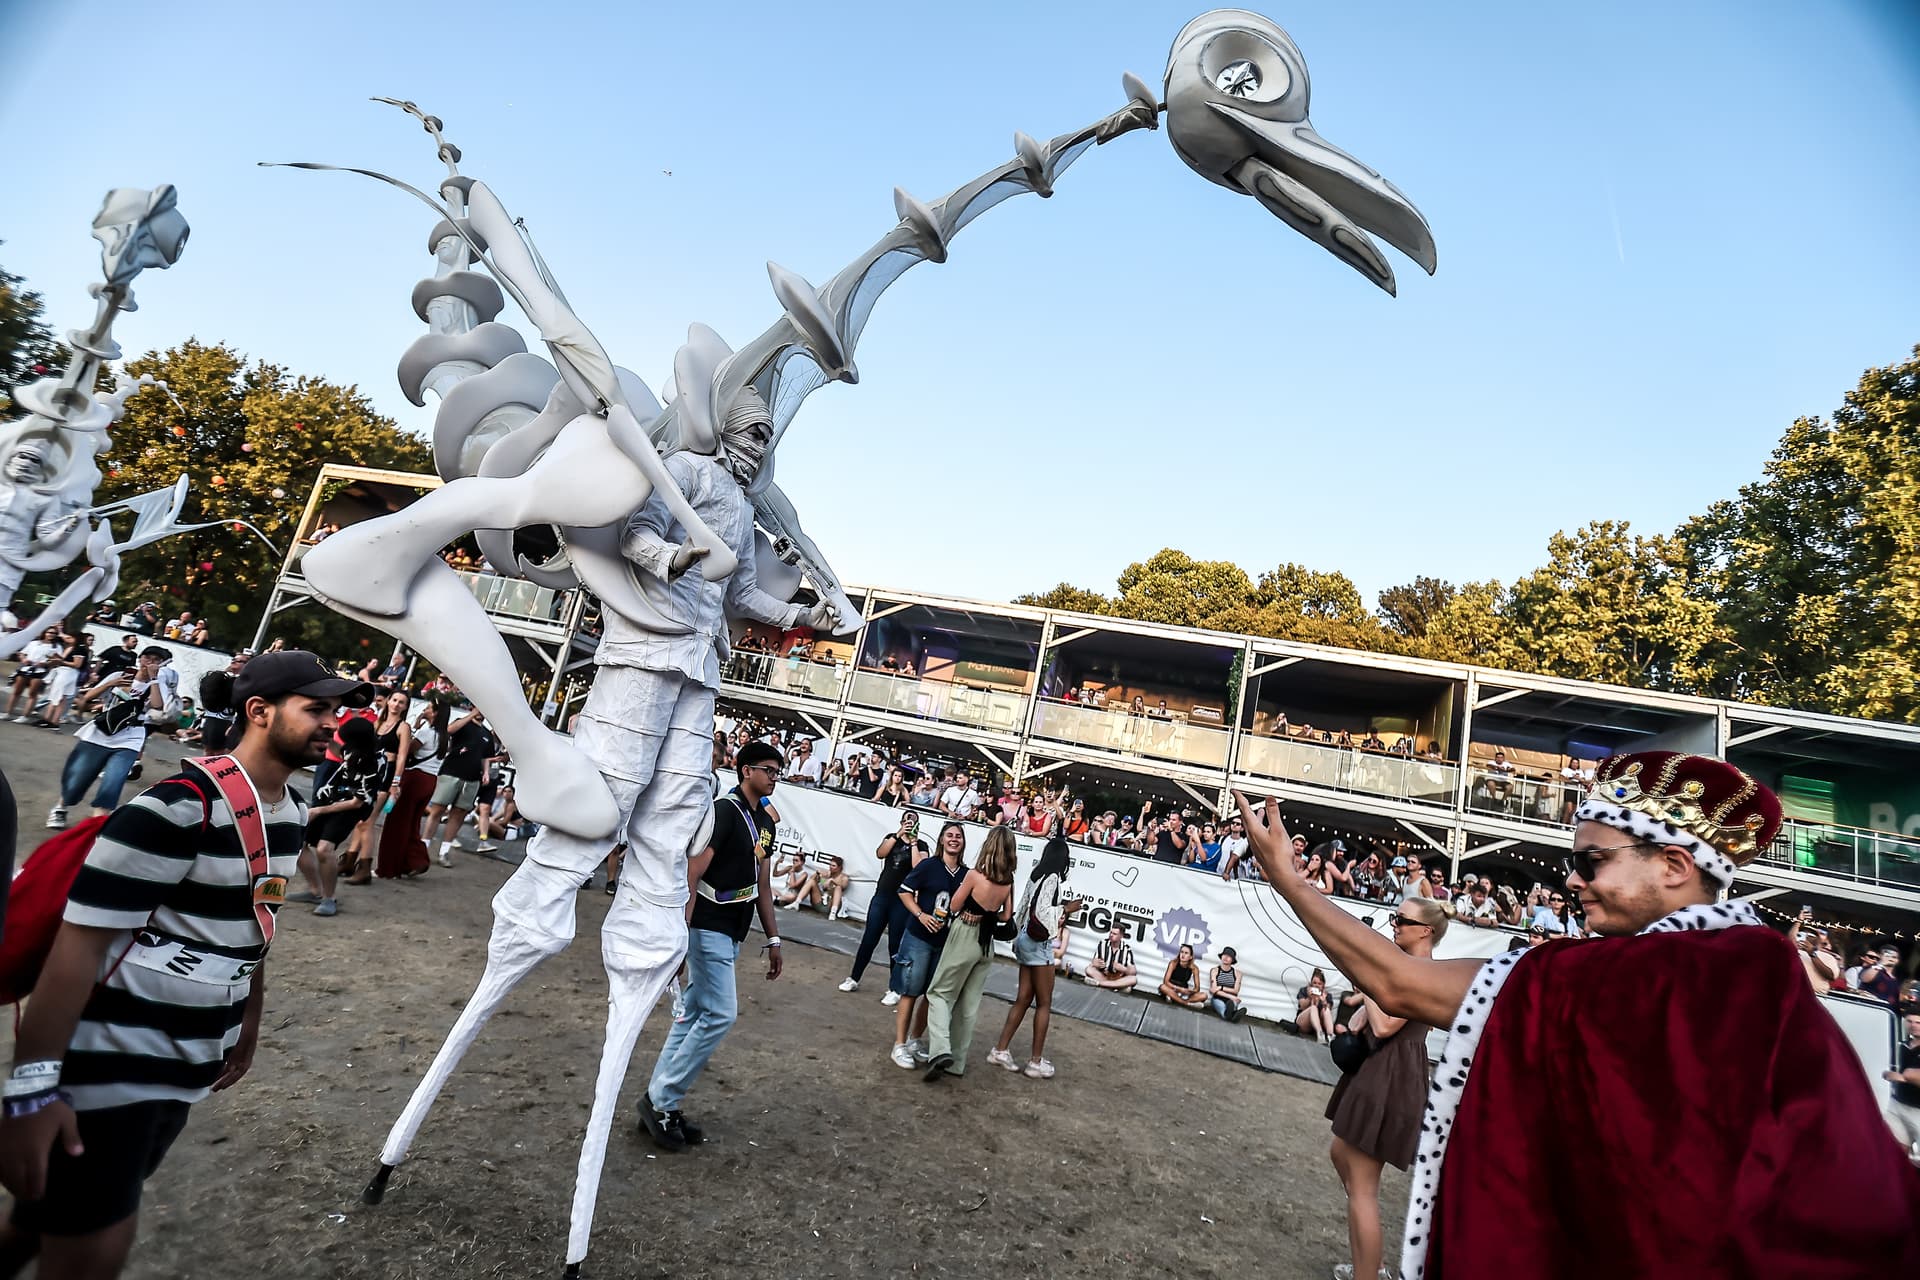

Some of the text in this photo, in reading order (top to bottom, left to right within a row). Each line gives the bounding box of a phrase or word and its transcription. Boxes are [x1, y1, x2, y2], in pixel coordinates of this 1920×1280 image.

[793, 829, 806, 844] by
[1097, 898, 1109, 906] OF
[1112, 901, 1154, 917] FREEDOM
[1160, 920, 1206, 946] VIP
